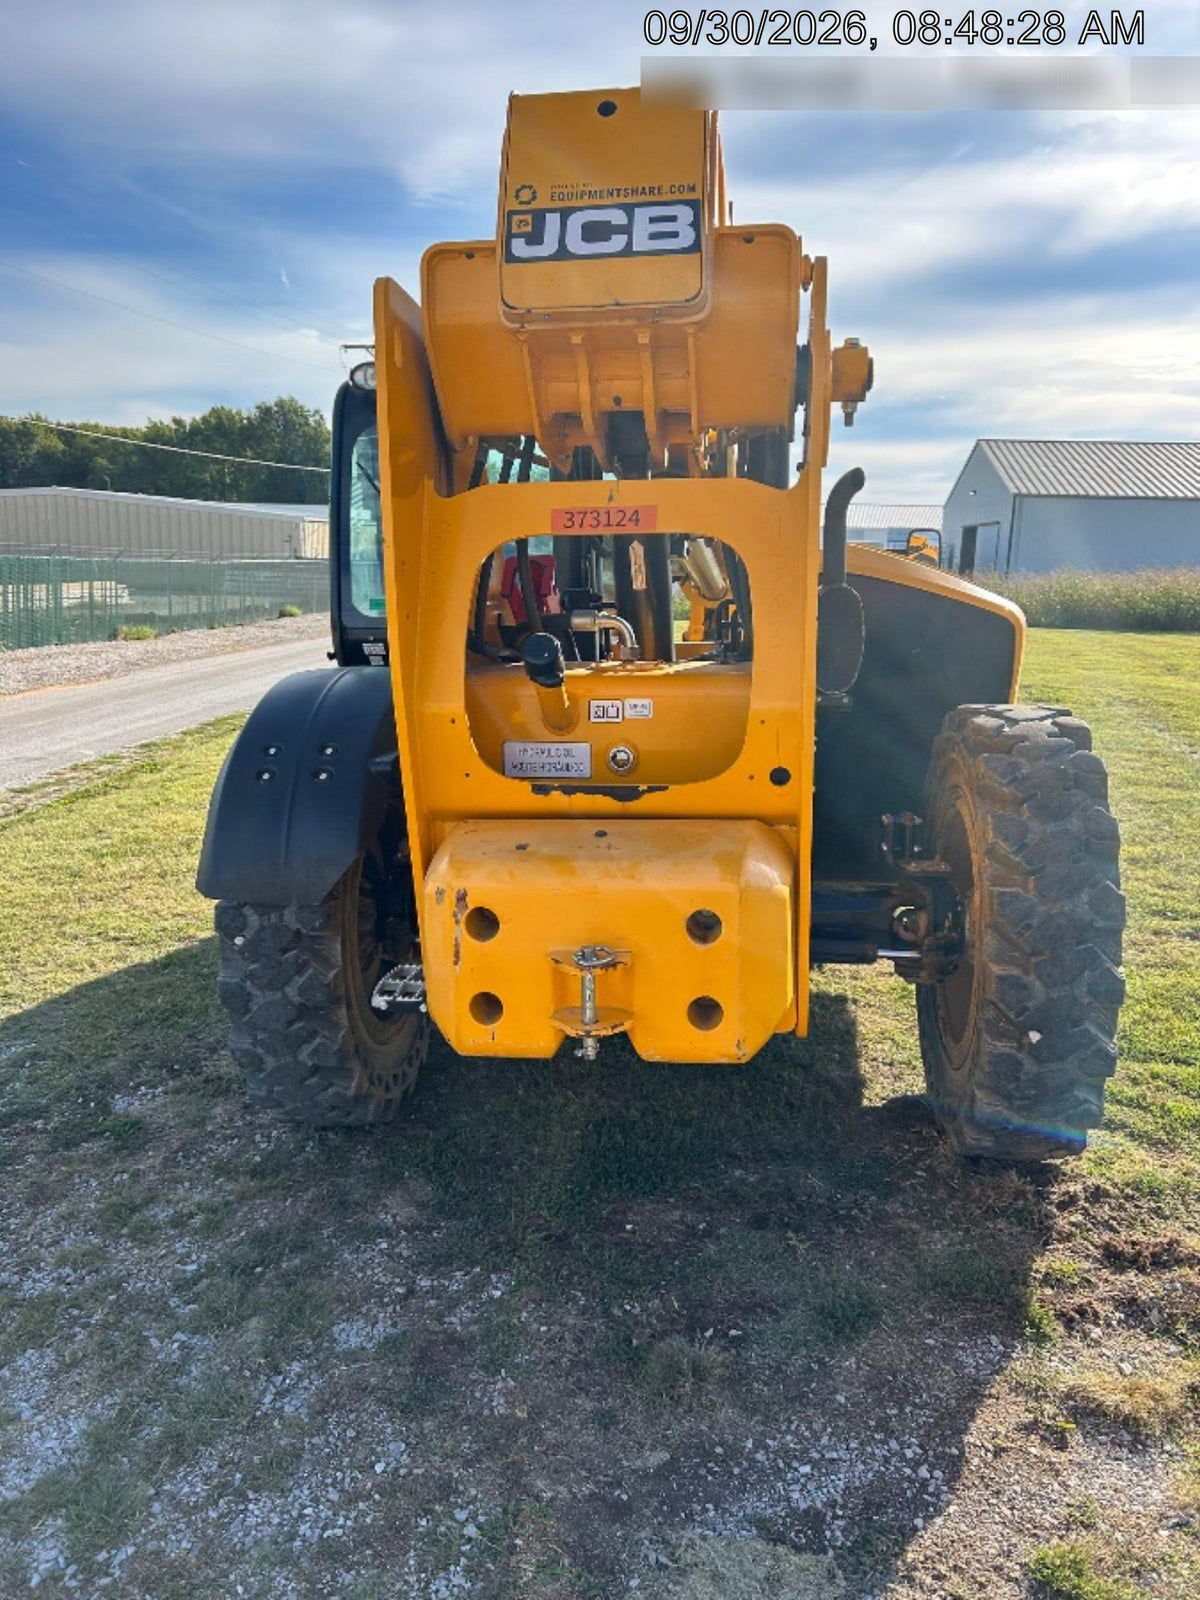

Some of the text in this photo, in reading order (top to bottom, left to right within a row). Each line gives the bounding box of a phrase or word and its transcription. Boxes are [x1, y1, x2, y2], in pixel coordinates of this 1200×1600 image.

[550, 183, 697, 201] EQUIPMENTSHARE.COM
[511, 204, 696, 258] JCB
[563, 509, 641, 529] 373124
